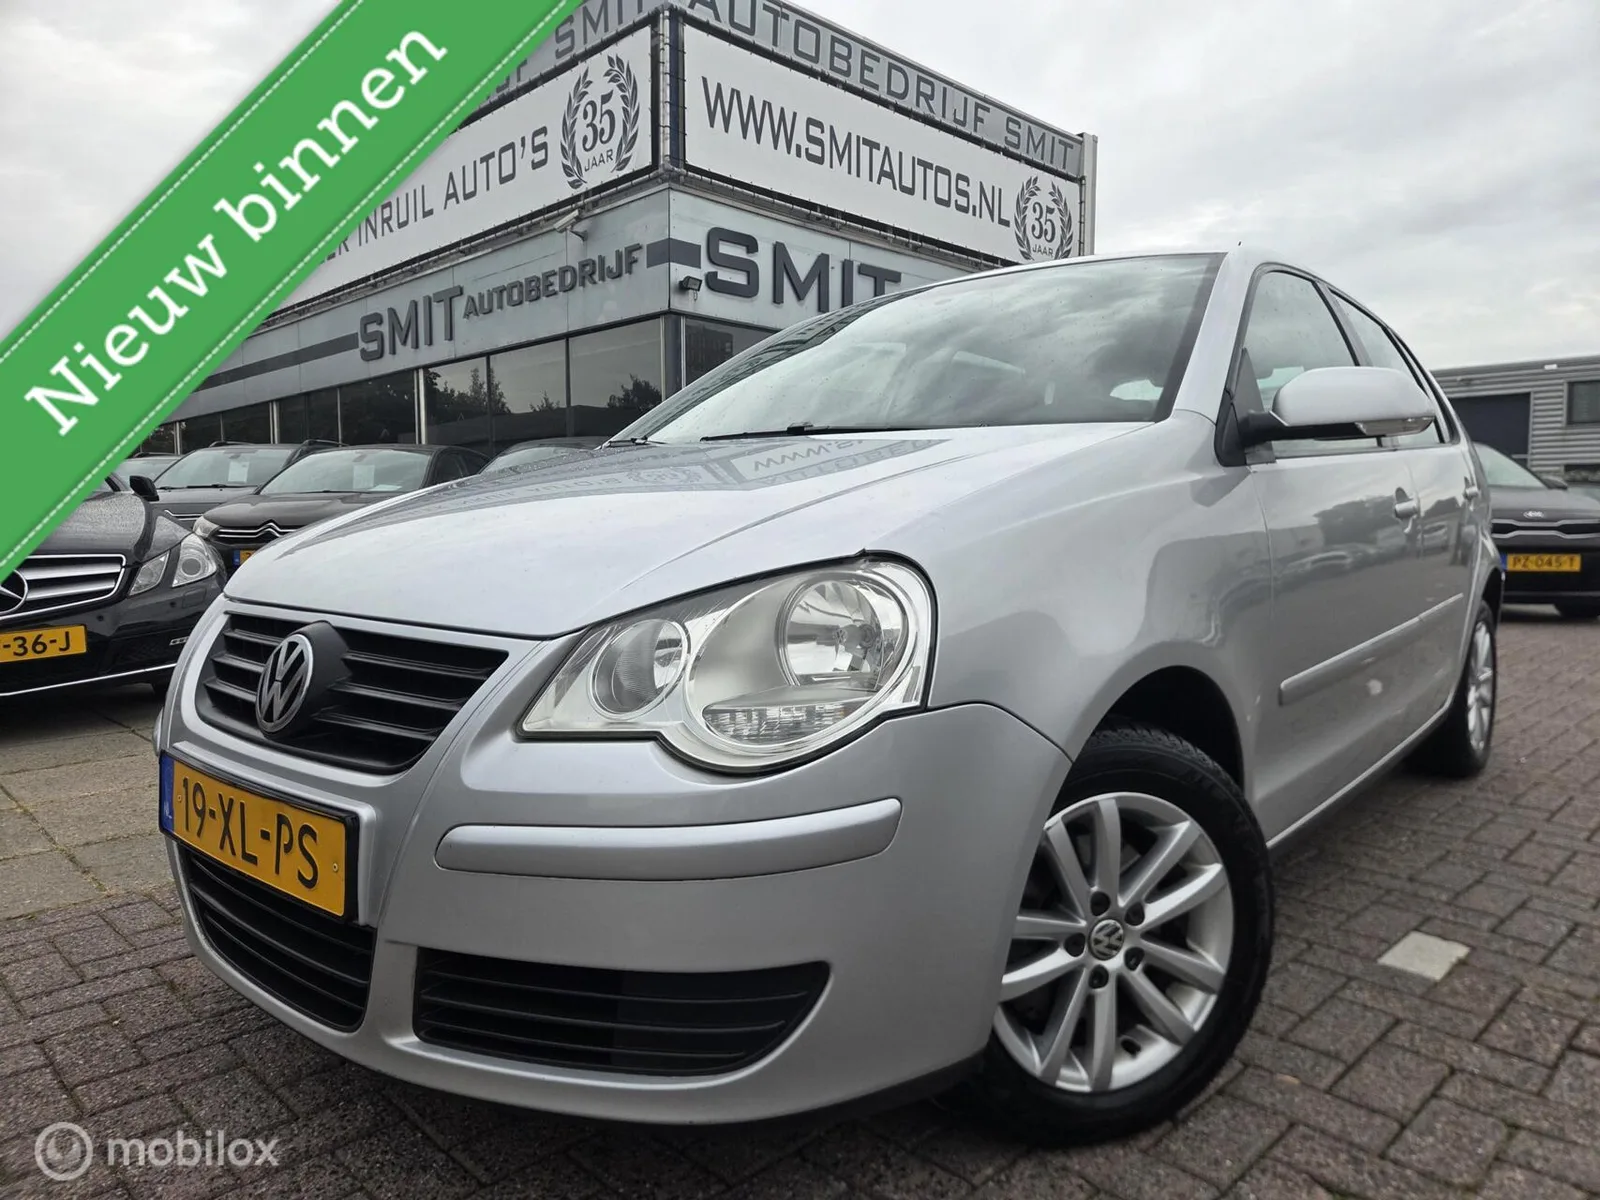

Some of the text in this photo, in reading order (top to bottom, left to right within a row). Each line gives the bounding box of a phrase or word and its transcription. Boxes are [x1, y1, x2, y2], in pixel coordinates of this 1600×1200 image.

[554, 0, 644, 60] SMI
[581, 90, 616, 152] 35
[701, 76, 1010, 228] WWW.SMITAUTOS.NL
[1004, 116, 1074, 170] SMIT
[357, 125, 549, 247] INRUIL AUTO'S
[584, 149, 614, 172] JAAR
[1031, 201, 1056, 243] 35
[1032, 246, 1054, 258] JAAR
[705, 226, 901, 314] SMIT
[359, 243, 643, 362] SMIT AUTOBEDRIJF
[182, 776, 319, 889] 19-XL-PS
